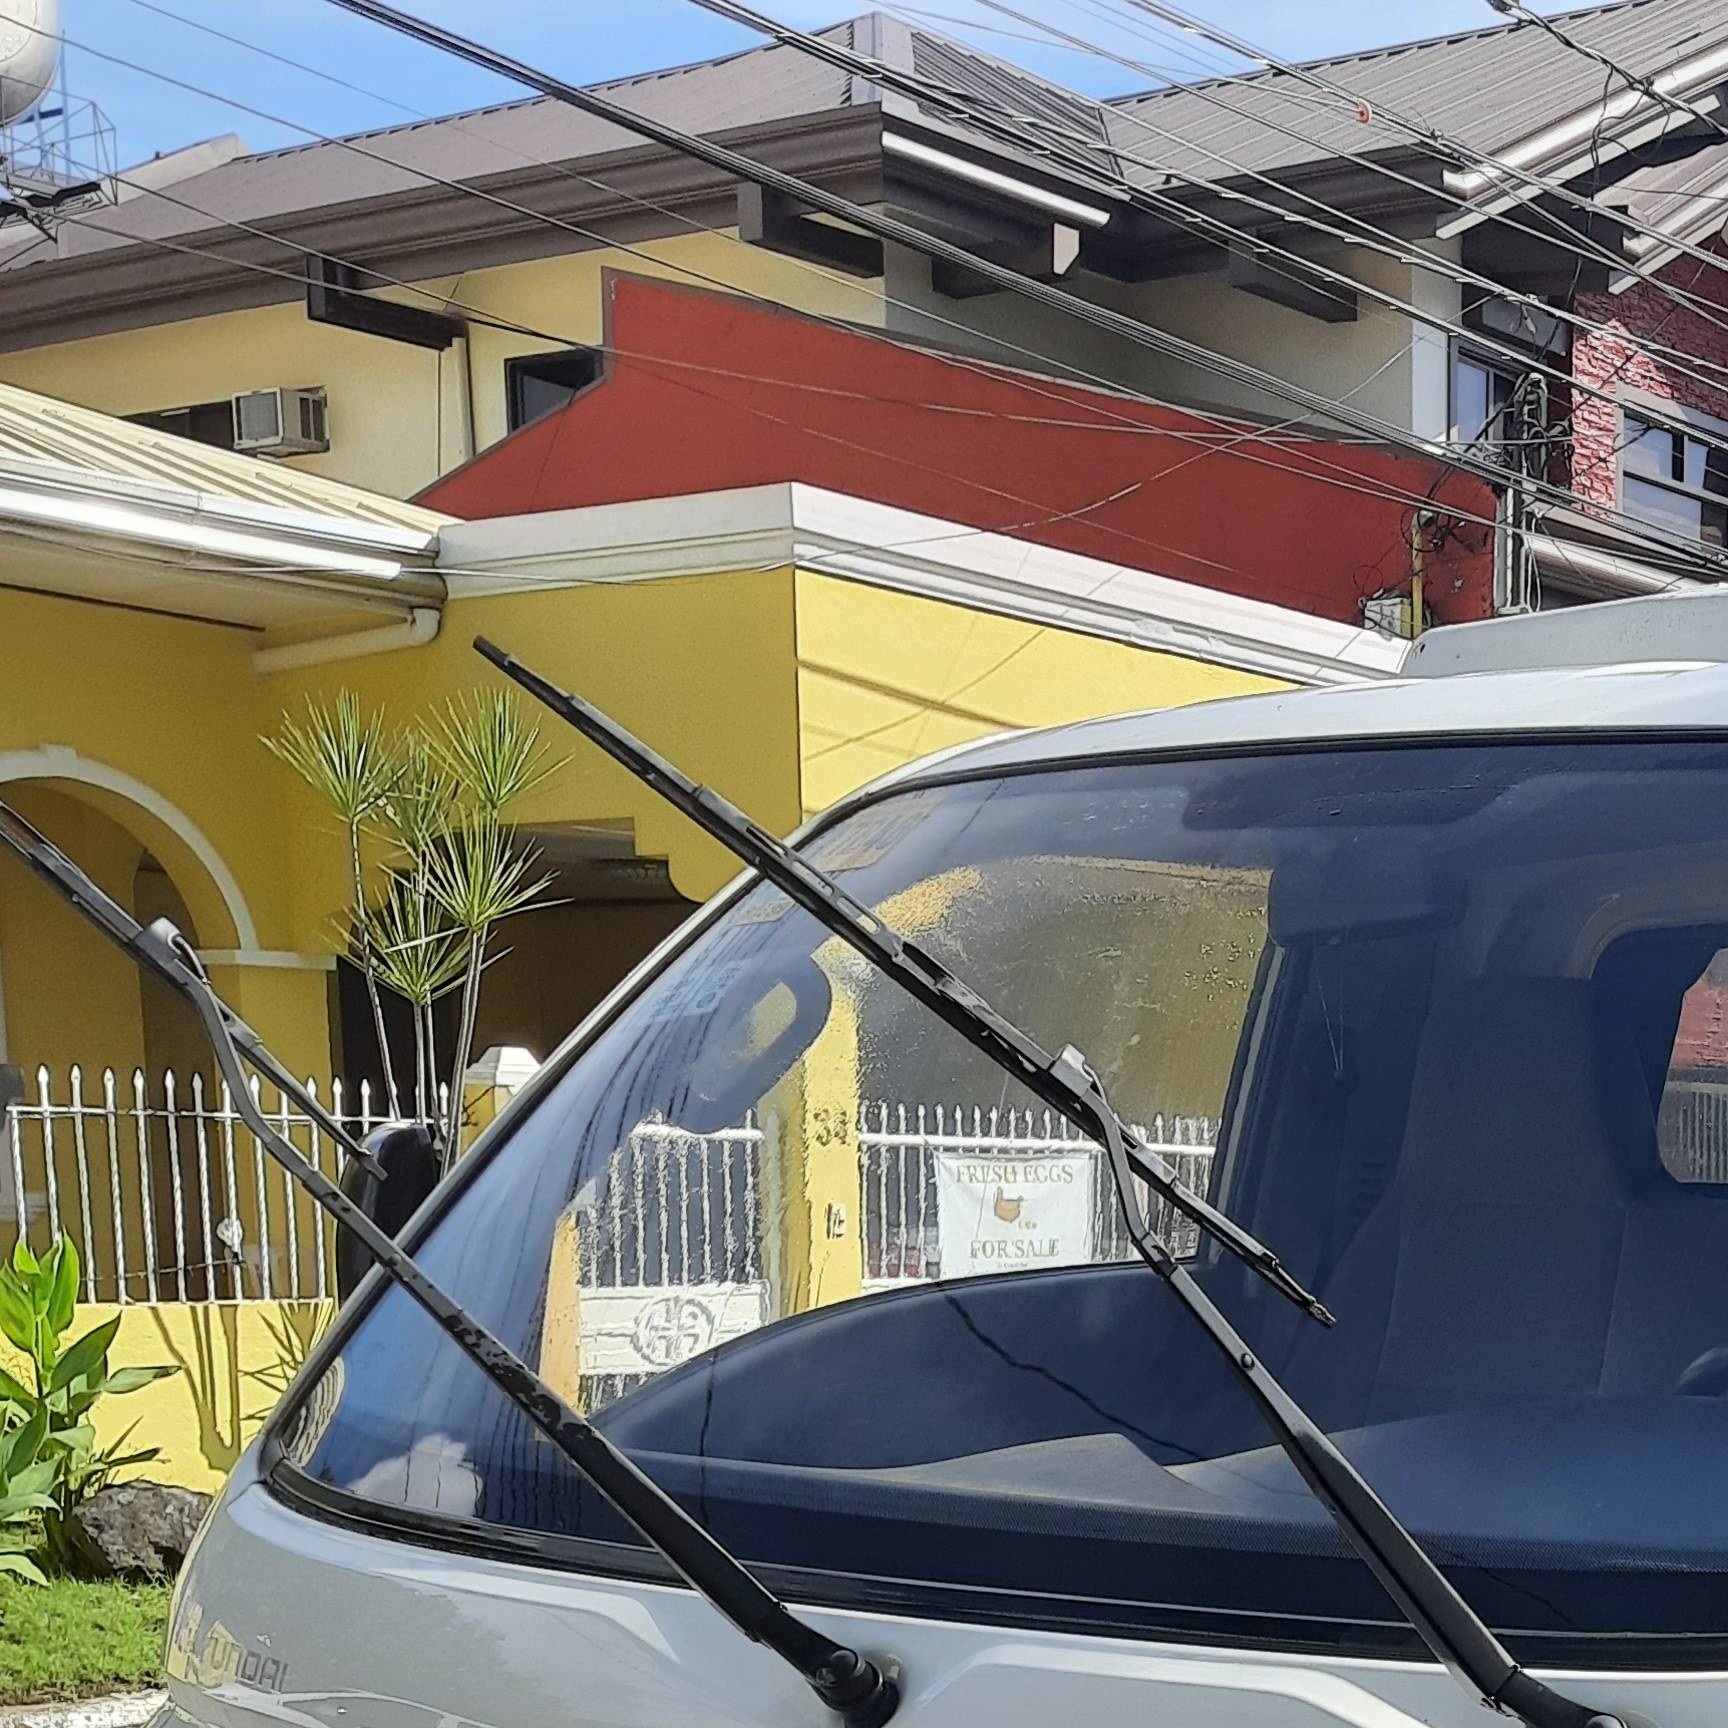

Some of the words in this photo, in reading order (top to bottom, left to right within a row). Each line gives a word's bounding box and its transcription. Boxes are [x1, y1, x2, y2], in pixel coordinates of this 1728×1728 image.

[955, 1164, 1018, 1186] FRESH
[1024, 1163, 1075, 1185] EGGS
[969, 1239, 1010, 1259] FOR
[1010, 1237, 1061, 1258] SALE
